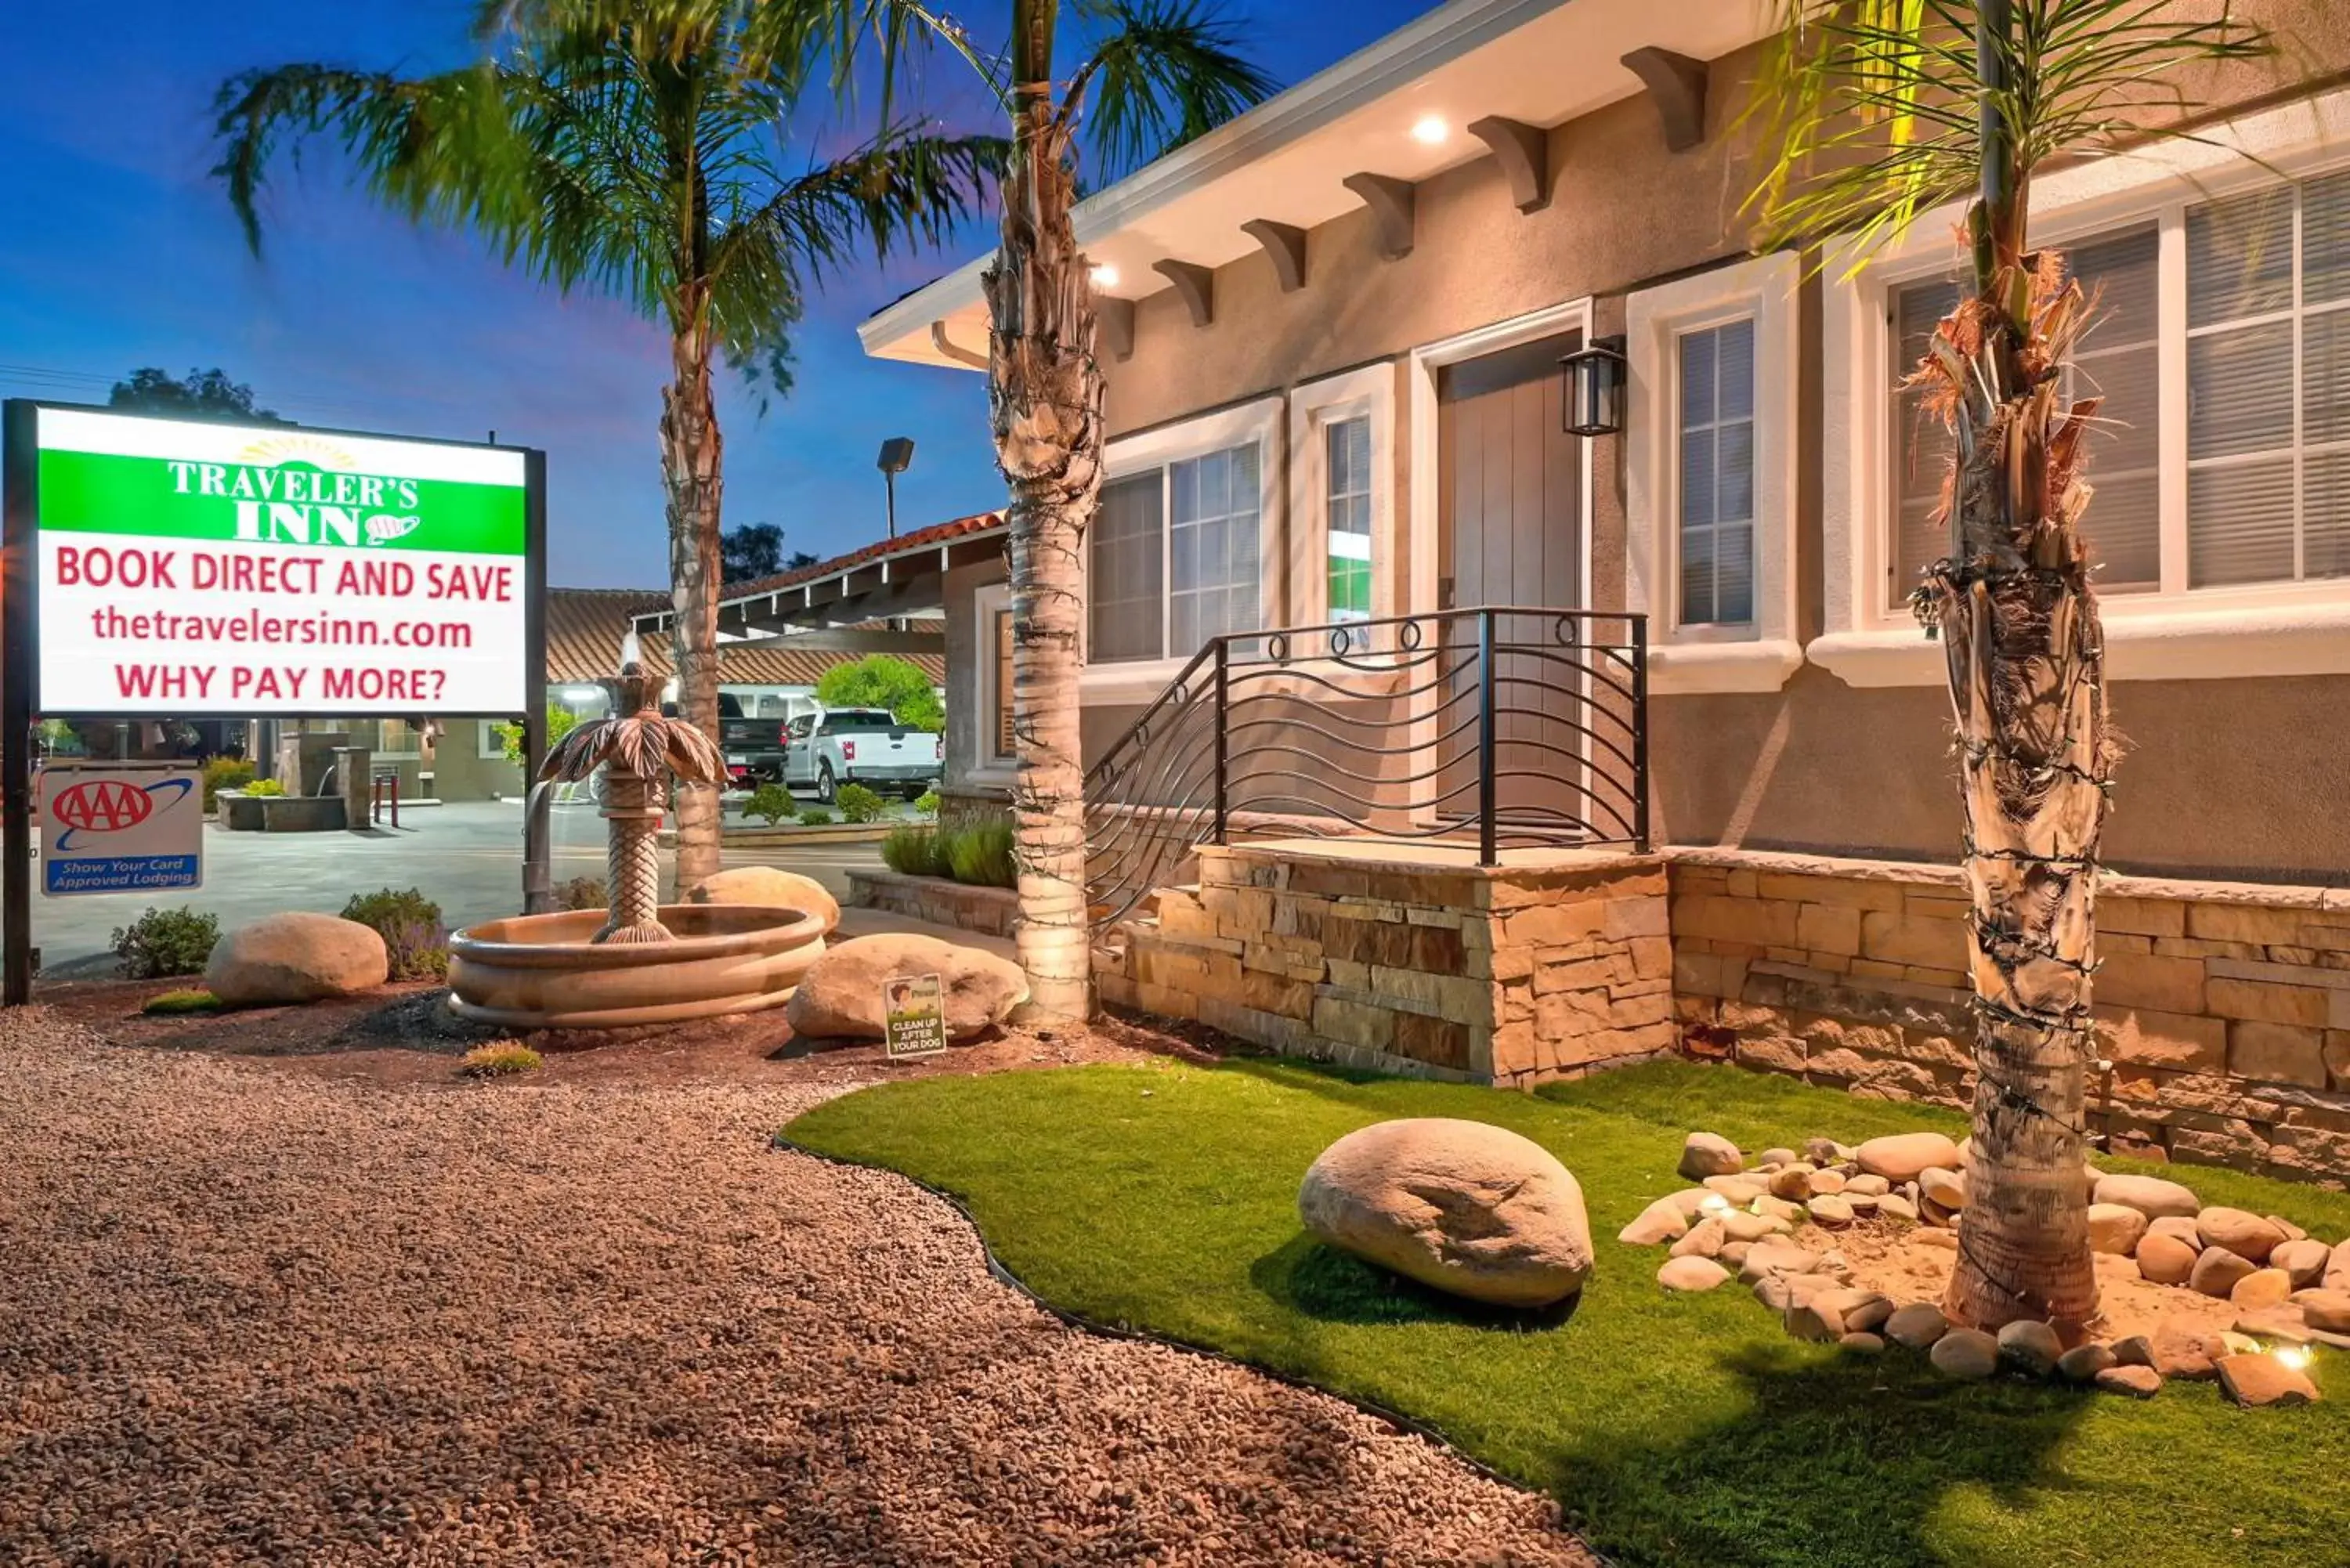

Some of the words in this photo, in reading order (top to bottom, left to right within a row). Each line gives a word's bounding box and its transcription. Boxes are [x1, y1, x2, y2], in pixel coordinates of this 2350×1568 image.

[168, 461, 419, 509] TRAVELER'S
[232, 500, 363, 546] INN
[57, 546, 176, 589] BOOK
[192, 553, 324, 594] DIRECT
[336, 560, 415, 598] AND
[427, 563, 512, 602] SAVE
[92, 606, 472, 649] thetravelersinn.com
[114, 663, 216, 699] WHY
[232, 666, 307, 699] PAY
[323, 668, 447, 700] MORE?
[63, 781, 146, 831] AAA
[54, 874, 128, 888] Approved
[132, 872, 193, 886] Lodging
[63, 862, 106, 874] Show
[112, 860, 146, 873] Your
[149, 858, 184, 871] Card
[892, 1019, 924, 1031] CLEAN
[925, 1018, 938, 1027] UP
[901, 1030, 933, 1040] AFTER
[893, 1041, 919, 1051] YOUR
[920, 1038, 942, 1048] DOG
